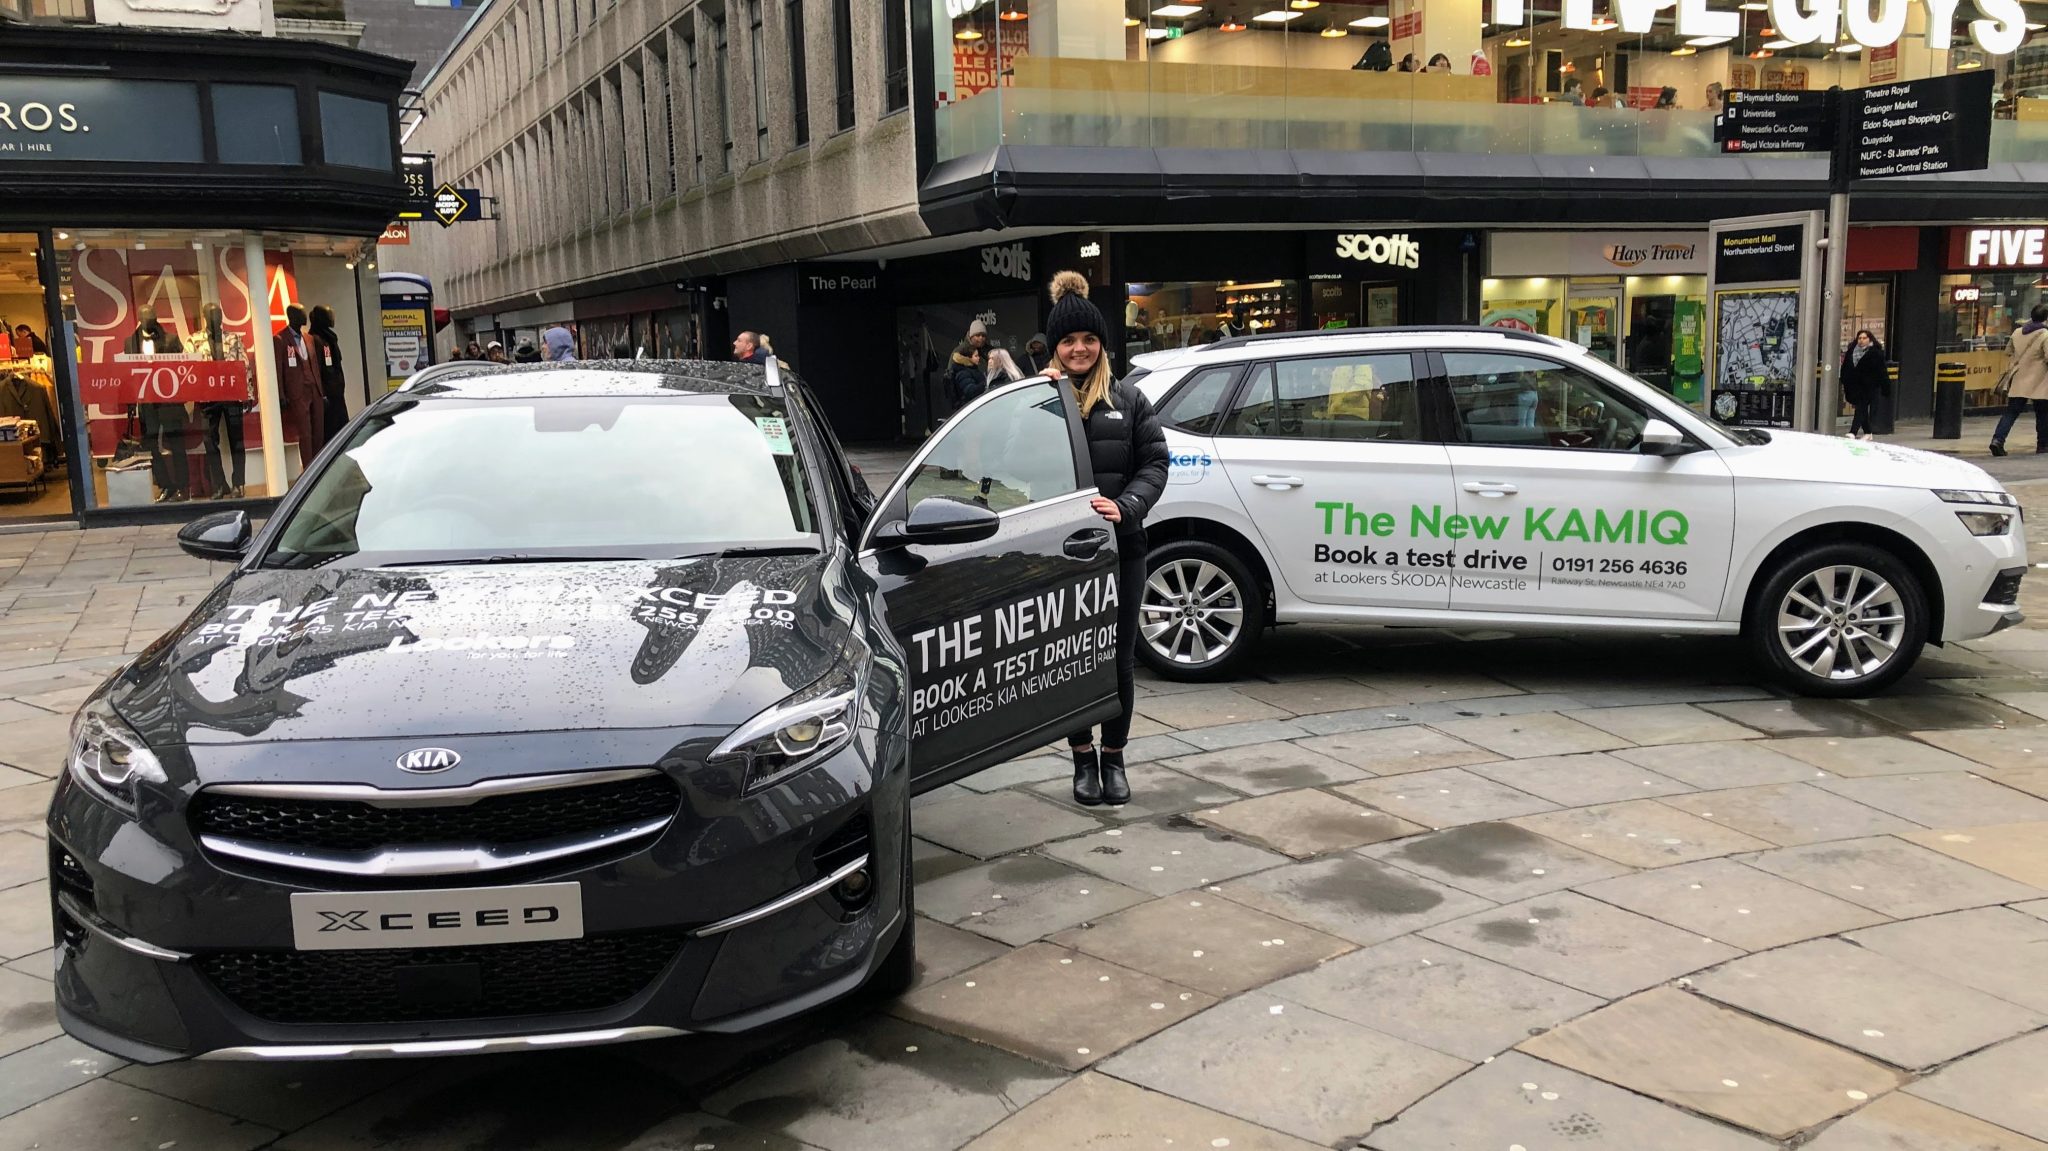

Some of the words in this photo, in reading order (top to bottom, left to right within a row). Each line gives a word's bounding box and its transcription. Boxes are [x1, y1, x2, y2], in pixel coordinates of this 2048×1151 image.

[1743, 93, 1774, 104] Haymarket
[1775, 92, 1799, 102] Stations
[1865, 89, 1890, 99] Theatre
[1891, 84, 1911, 95] Royal
[1743, 108, 1776, 118] Universities
[1864, 104, 1893, 115] Grainger
[1894, 100, 1918, 110] Market
[1741, 125, 1772, 134] Newcastle
[1773, 124, 1788, 133] Civic
[1788, 124, 1809, 133] Centre
[1862, 120, 1881, 130] Eldon
[1882, 116, 1906, 129] Square
[1907, 113, 1941, 126] Shopping
[27, 143, 52, 152] HIRE
[1741, 140, 1758, 151] Royal
[1759, 140, 1780, 149] Victoria
[1780, 139, 1805, 150] Infirmary
[1861, 134, 1893, 146] Quayside
[1860, 150, 1882, 161] NUFC
[1887, 148, 1895, 159] St
[1896, 146, 1922, 157] James'
[1921, 145, 1939, 155] Park
[1860, 165, 1895, 176] Newcastle
[1895, 162, 1922, 173] Central
[1922, 161, 1948, 171] Station
[1723, 236, 1760, 246] Monument
[1761, 234, 1777, 243] Mall
[1968, 229, 2045, 266] FIVE
[1080, 241, 1101, 258] scotts
[1335, 233, 1419, 269] scotts
[1611, 244, 1647, 265] Hays
[1651, 243, 1695, 261] Travel
[1723, 245, 1773, 257] Northumberland
[1774, 243, 1795, 253] Street
[981, 242, 1031, 281] scotts
[808, 275, 837, 290] The
[840, 275, 877, 289] Pearl
[1322, 285, 1343, 298] scotts
[1955, 288, 1980, 301] OPEN
[1973, 365, 1992, 375] GUYS
[91, 377, 107, 390] up
[109, 376, 122, 387] to
[131, 365, 198, 400] 70%
[208, 375, 237, 388] OFF
[1315, 501, 1395, 537] The
[1410, 504, 1510, 540] New
[1523, 506, 1689, 545] KAMIQ
[1314, 543, 1378, 566] Book
[1385, 551, 1399, 567] a
[1406, 547, 1456, 568] test
[1463, 549, 1528, 570] drive
[1552, 557, 1594, 573] 0191
[1599, 558, 1634, 574] 256
[1639, 560, 1688, 576] 4636
[1314, 572, 1329, 583] at
[1332, 572, 1387, 586] Lookers
[1391, 570, 1447, 588] ŠKODA
[1451, 575, 1527, 591] Newcastle
[1551, 576, 1583, 588] Railway
[1599, 579, 1643, 589] Newcastle
[1644, 580, 1664, 589] NE4
[1666, 581, 1686, 590] 7AD
[306, 614, 327, 626] A
[637, 605, 699, 624] 256
[911, 614, 983, 674] THE
[995, 588, 1066, 649] NEW
[1074, 572, 1119, 622] KIA
[188, 635, 222, 646] AT
[342, 619, 378, 633] KIA
[769, 619, 794, 630] 7AD
[385, 631, 576, 654] Lookers
[467, 651, 488, 661] for
[489, 652, 519, 660] you,
[523, 651, 543, 659] for
[547, 650, 568, 659] life
[912, 671, 969, 715] BOOK
[973, 667, 987, 693] A
[993, 647, 1040, 685] TEST
[1043, 628, 1094, 667] DRIVE
[912, 716, 929, 740] AT
[933, 692, 994, 732] LOOKERS
[997, 686, 1018, 708] KIA
[1021, 655, 1093, 698] NEWCASTLE
[406, 750, 450, 768] KIA
[317, 905, 559, 933] XCEED
